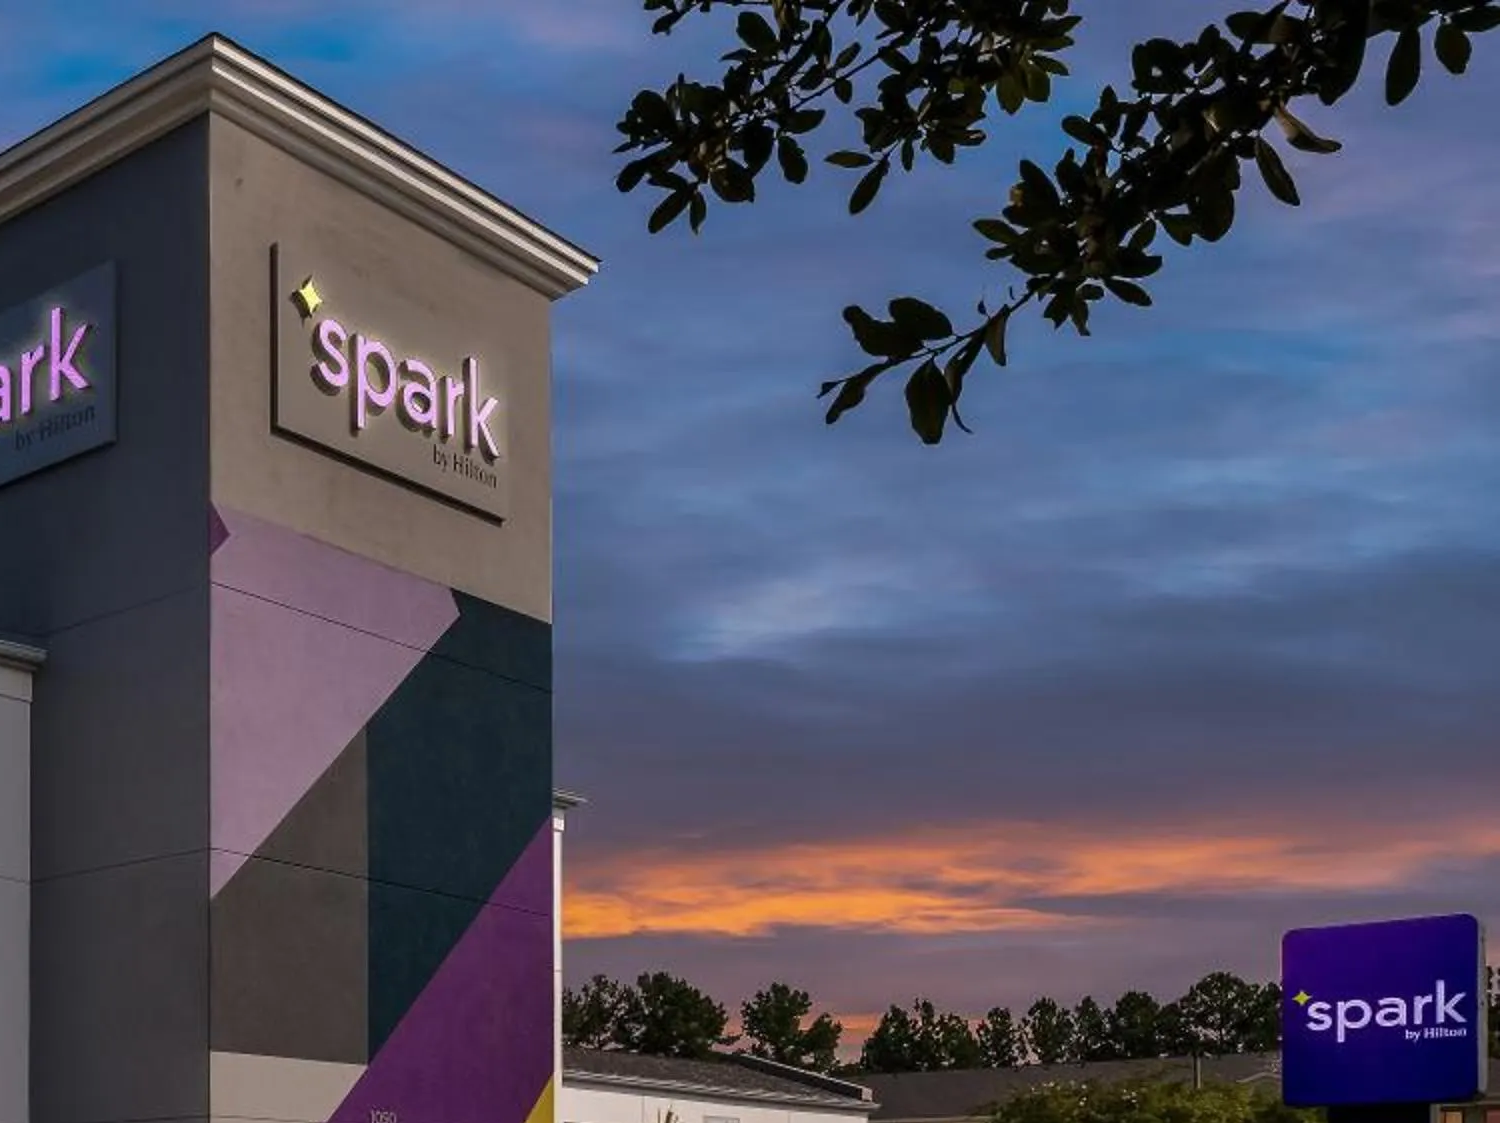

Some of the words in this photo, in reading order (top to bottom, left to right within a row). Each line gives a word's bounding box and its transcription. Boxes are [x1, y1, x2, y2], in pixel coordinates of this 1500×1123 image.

[311, 318, 500, 460] spark
[433, 444, 448, 473] by
[453, 452, 497, 489] Hilton
[1306, 979, 1468, 1043] spark
[1405, 1029, 1421, 1043] by
[1423, 1027, 1467, 1039] Hilton
